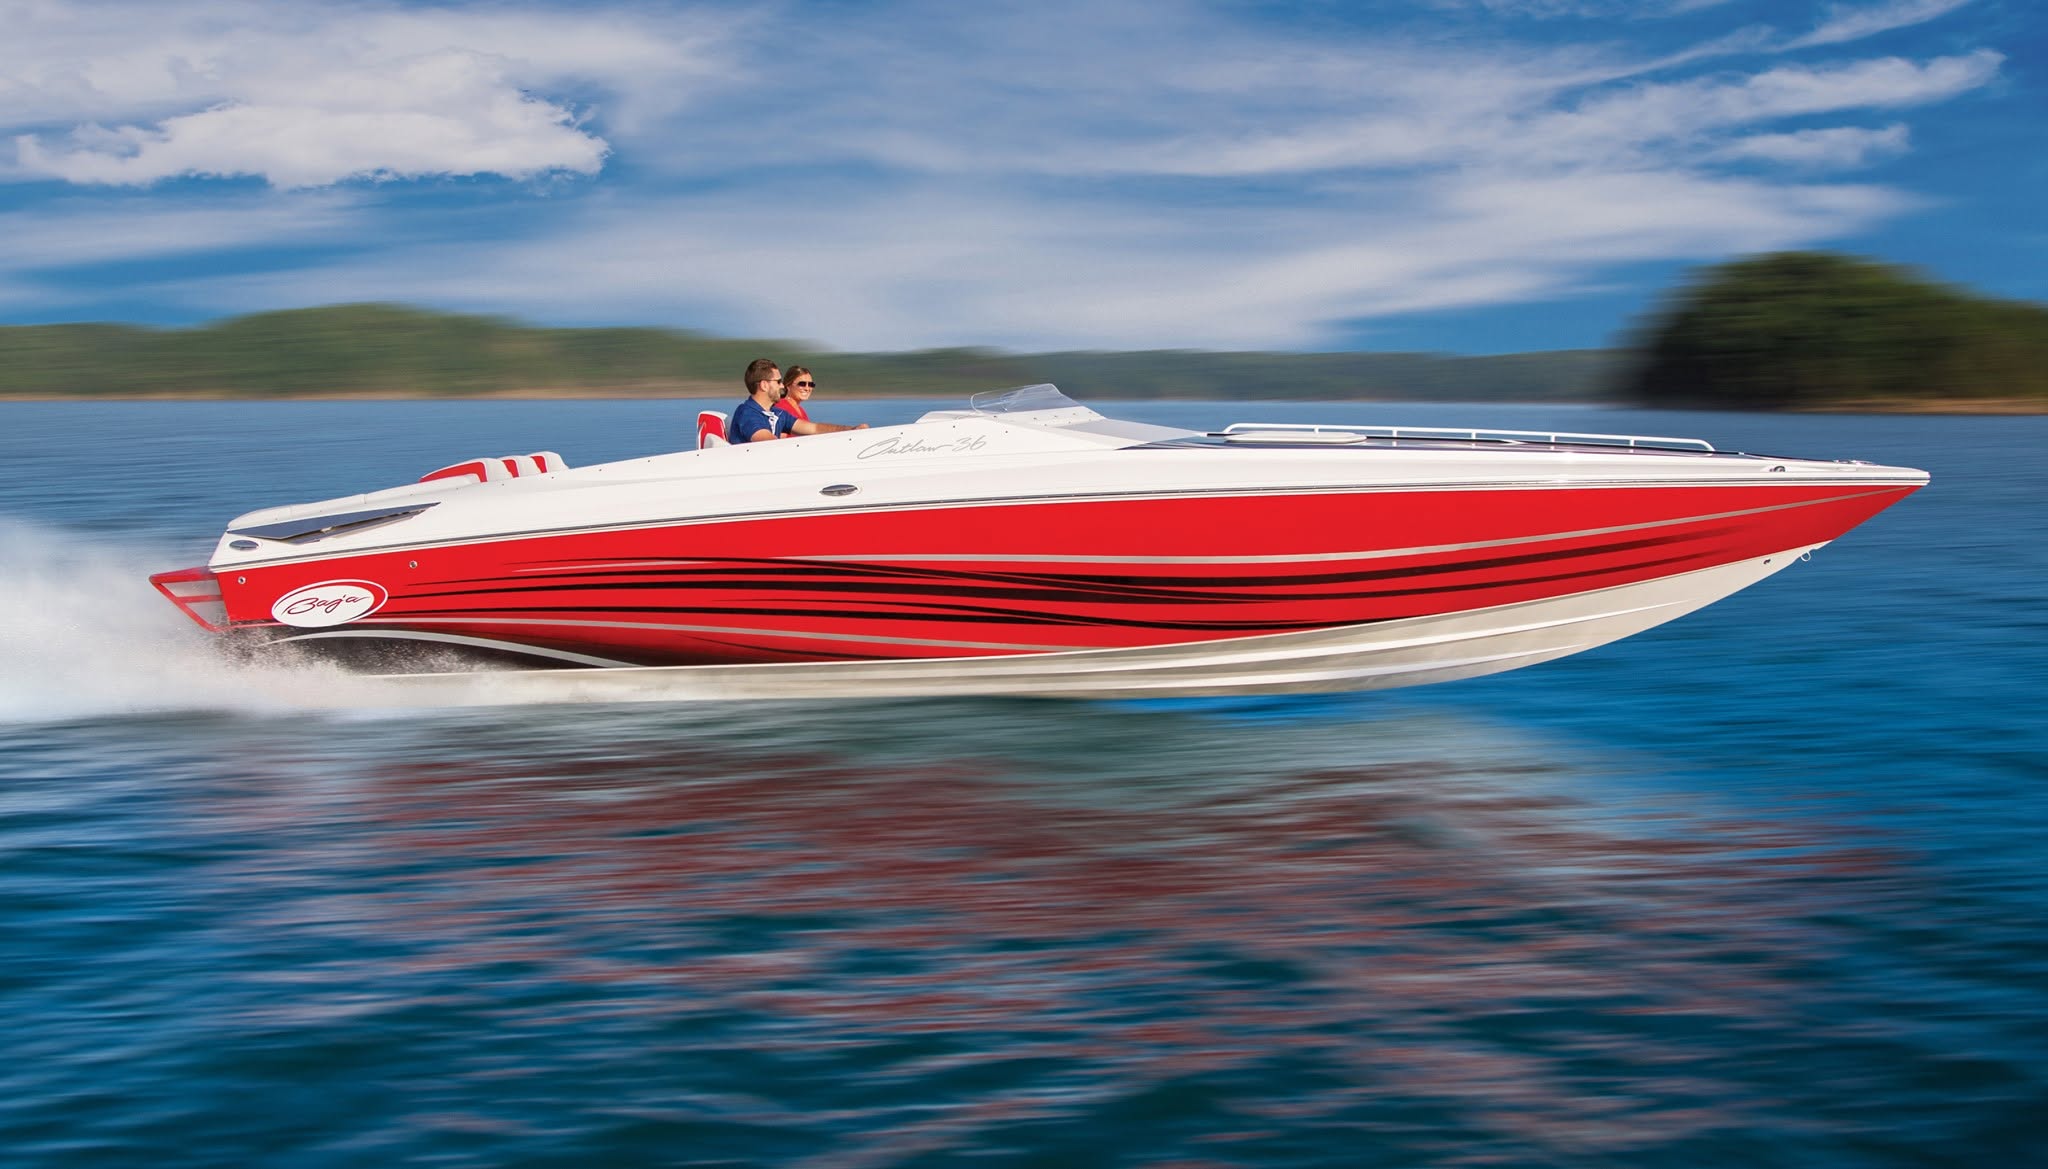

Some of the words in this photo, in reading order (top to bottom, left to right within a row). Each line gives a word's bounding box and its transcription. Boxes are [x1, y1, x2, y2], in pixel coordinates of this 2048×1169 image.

[857, 437, 952, 460] Outlaw
[952, 435, 987, 451] 36
[281, 594, 371, 616] Baja
